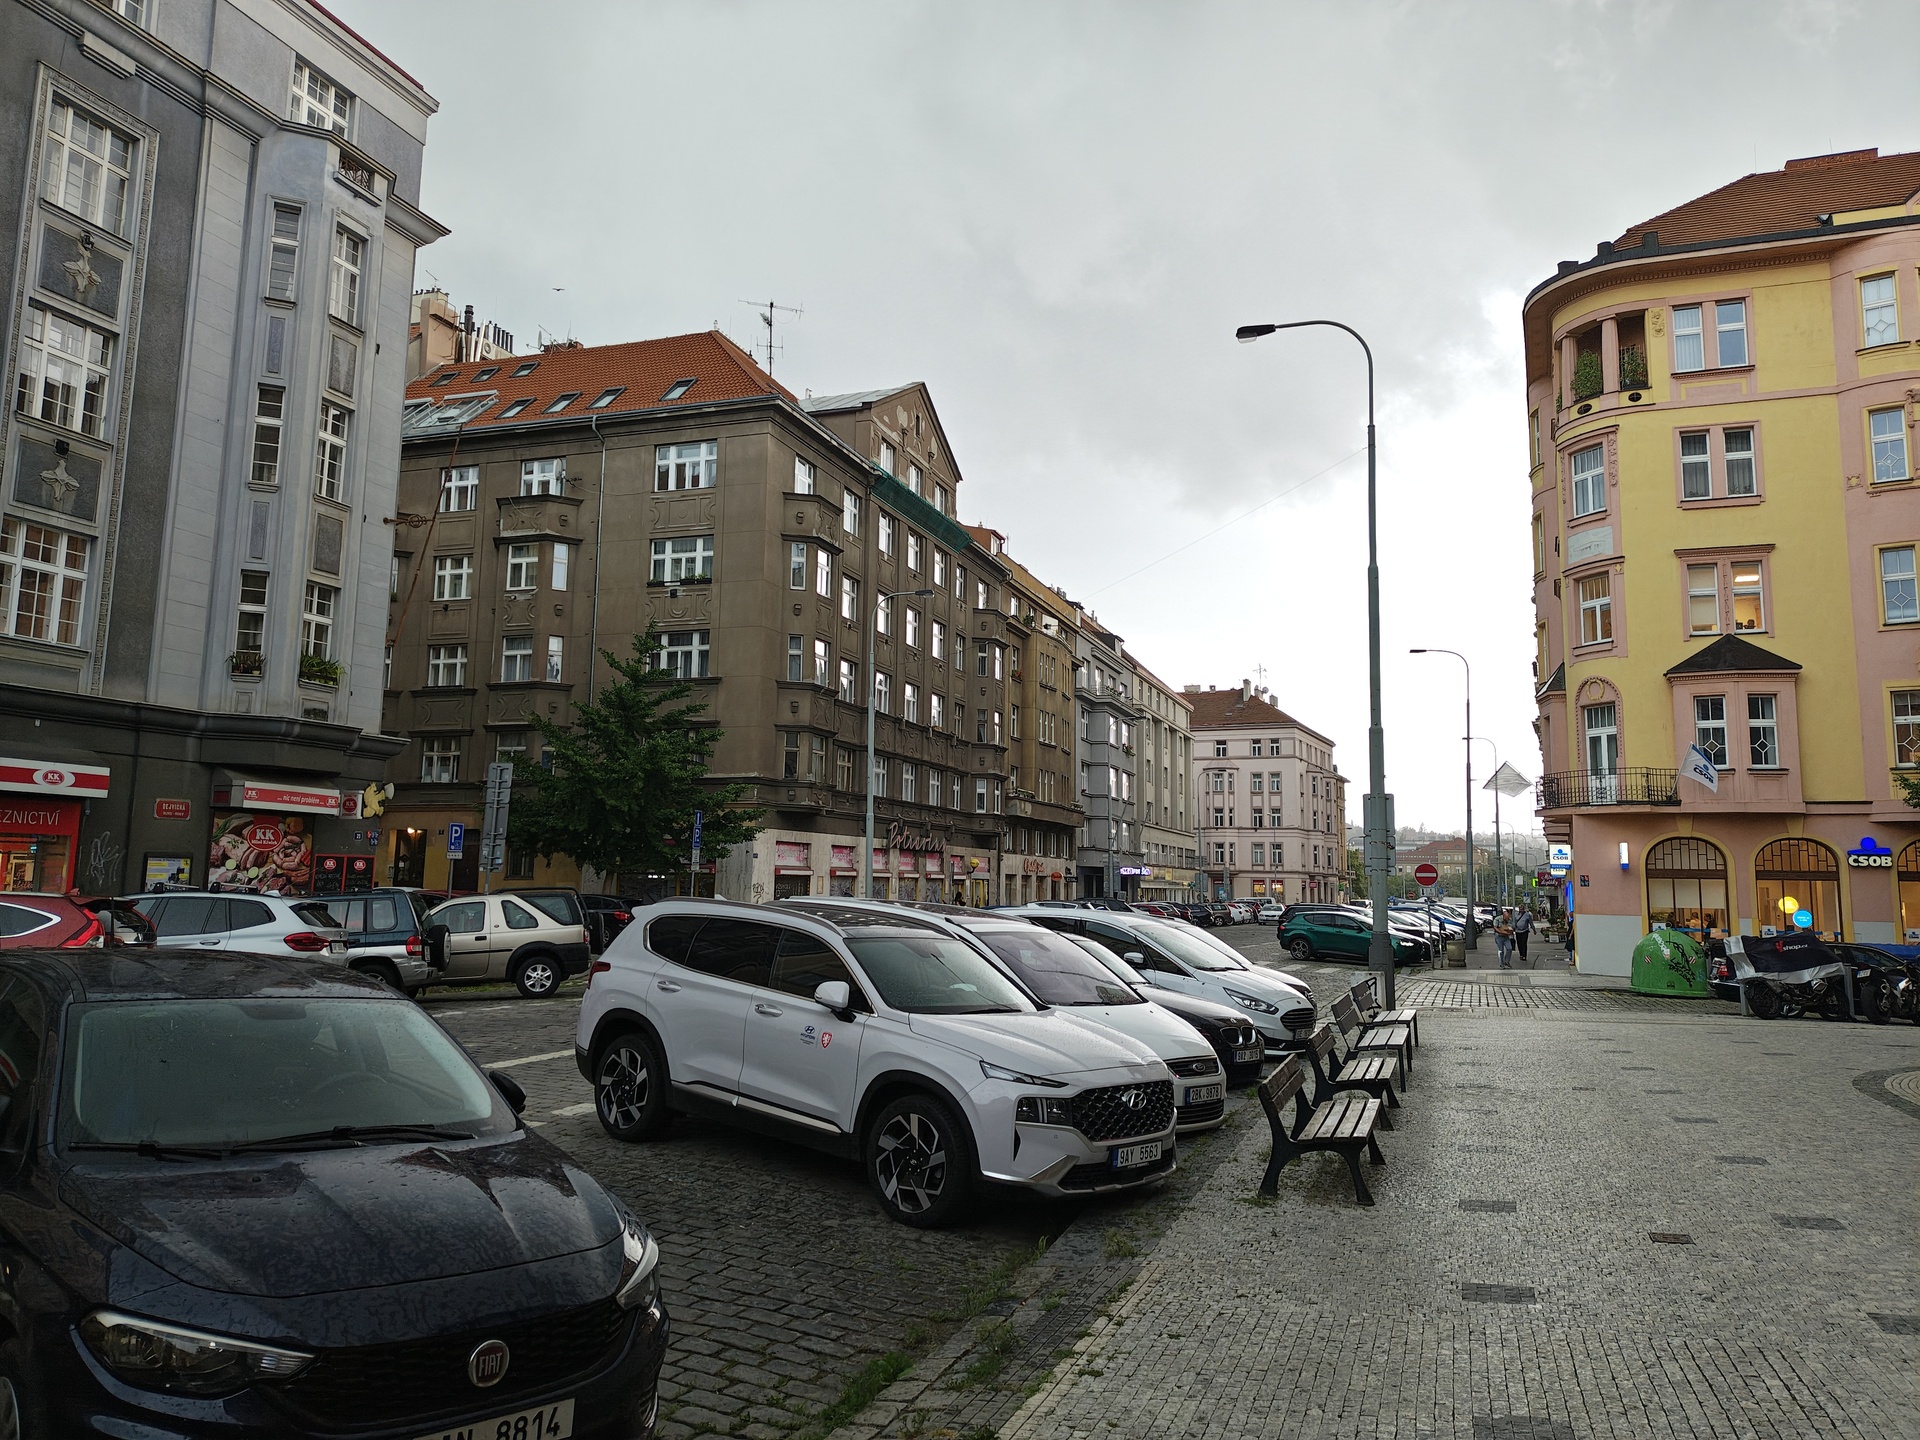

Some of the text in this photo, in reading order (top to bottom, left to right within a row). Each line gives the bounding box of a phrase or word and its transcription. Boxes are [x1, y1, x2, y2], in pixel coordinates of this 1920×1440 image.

[47, 772, 60, 781] KK
[255, 829, 275, 840] KK
[451, 826, 461, 843] P
[1848, 854, 1893, 867] ČSOB
[1120, 1148, 1135, 1165] 9AY
[478, 1352, 503, 1377] FIAT
[495, 1406, 560, 1440] 8814
